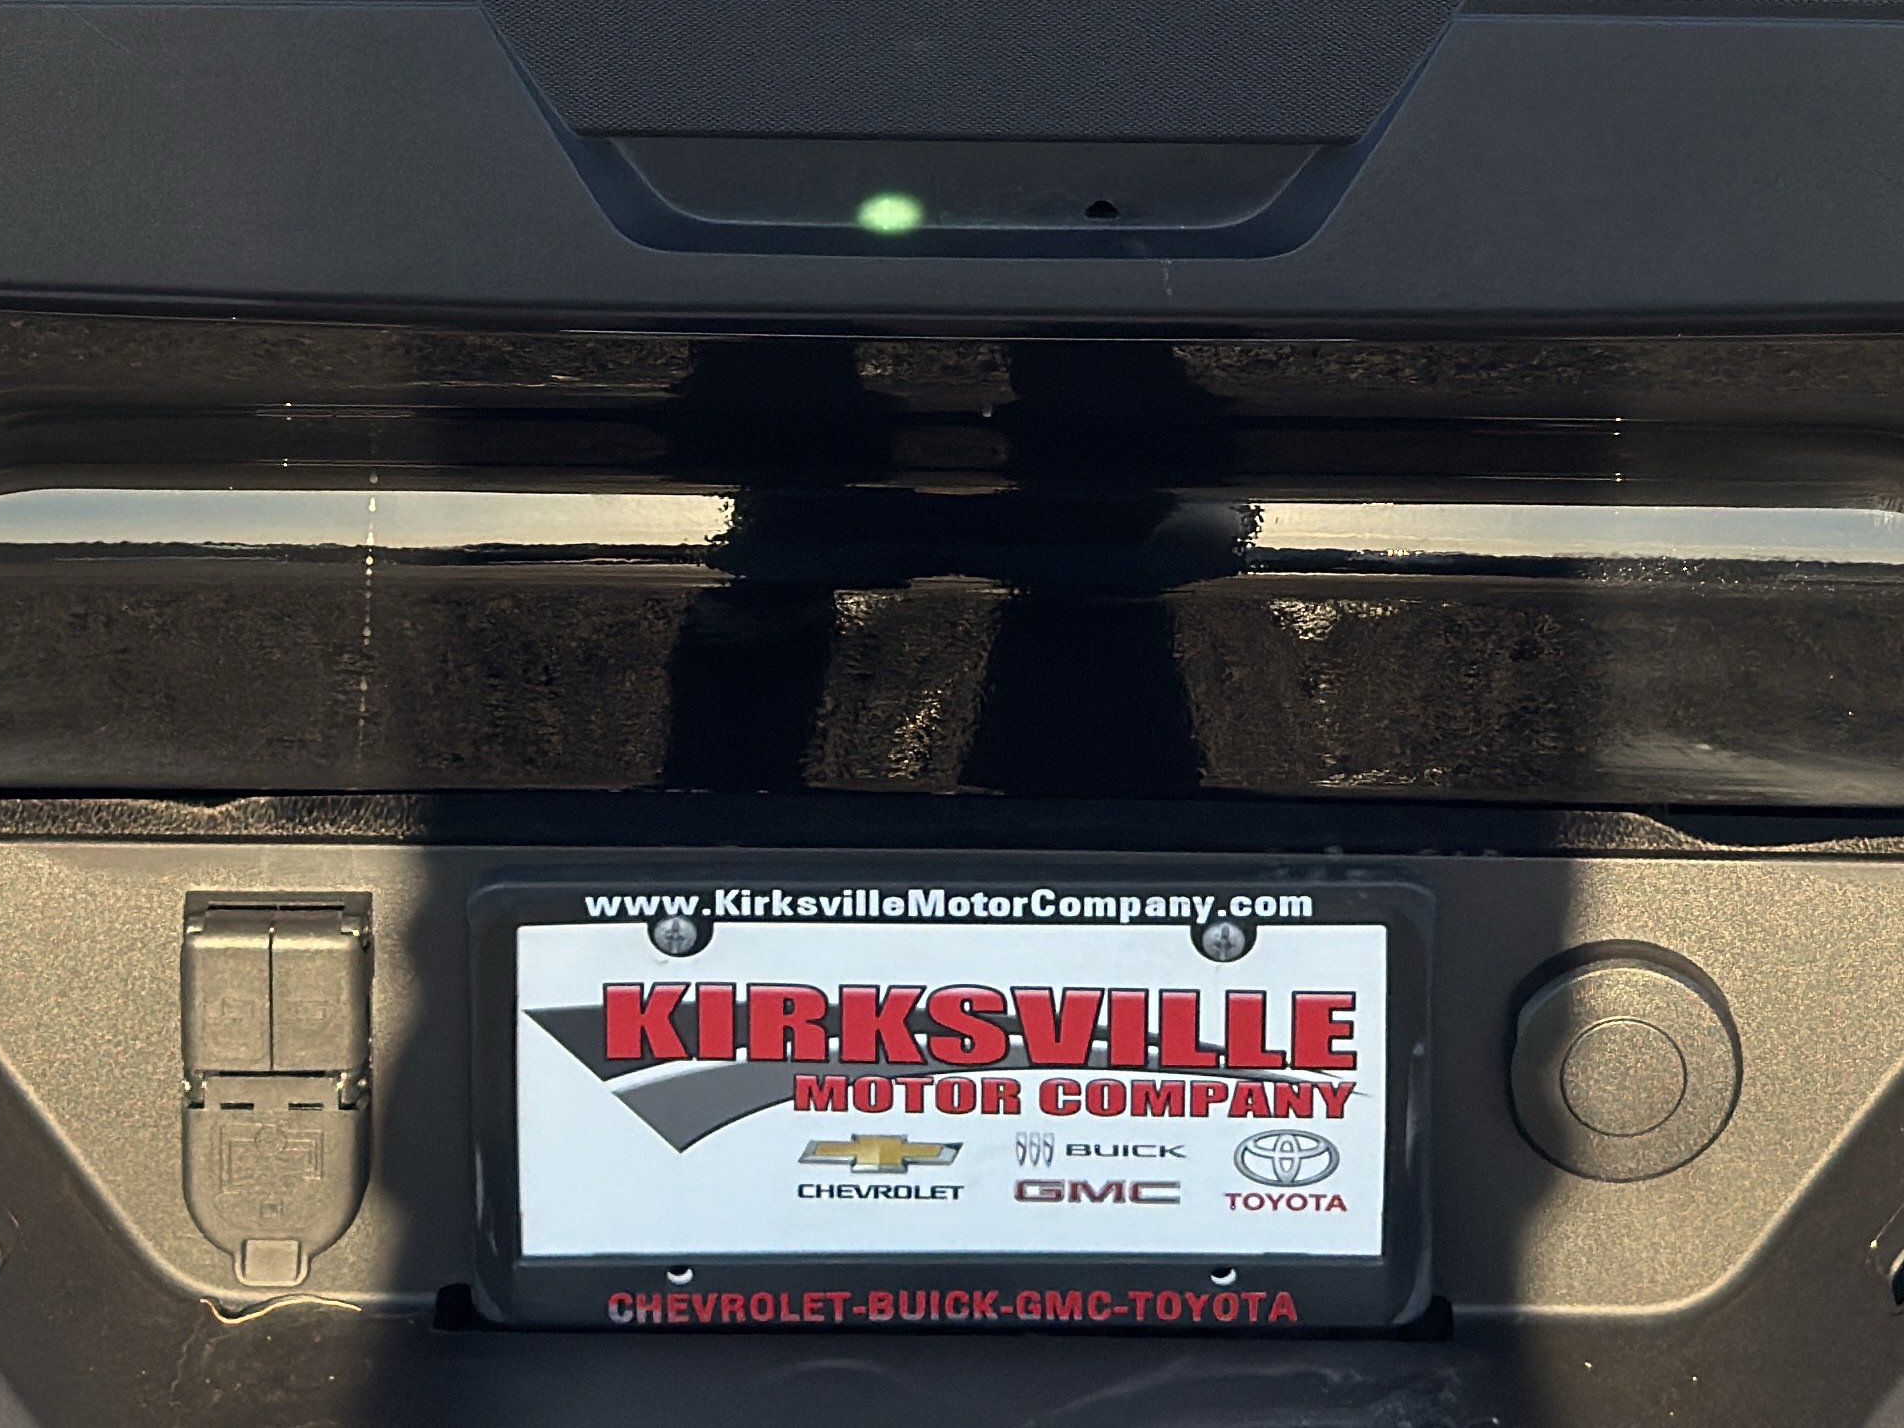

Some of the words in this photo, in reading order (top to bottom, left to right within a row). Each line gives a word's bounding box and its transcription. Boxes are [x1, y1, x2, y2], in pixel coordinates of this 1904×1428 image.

[585, 889, 1313, 922] www.KirksvilleMotorCompany.com
[601, 982, 1356, 1069] KIRKSVILLE
[793, 1074, 1021, 1116] MOTOR
[1038, 1078, 1353, 1120] COMPANY
[1065, 1143, 1186, 1160] BUICK
[797, 1183, 964, 1201] CHEVROLET
[1014, 1178, 1181, 1206] GMC
[1224, 1192, 1347, 1213] TOYOTA
[607, 1290, 1298, 1324] CHEVROLET-BUICK-GMC-TOYOTA
